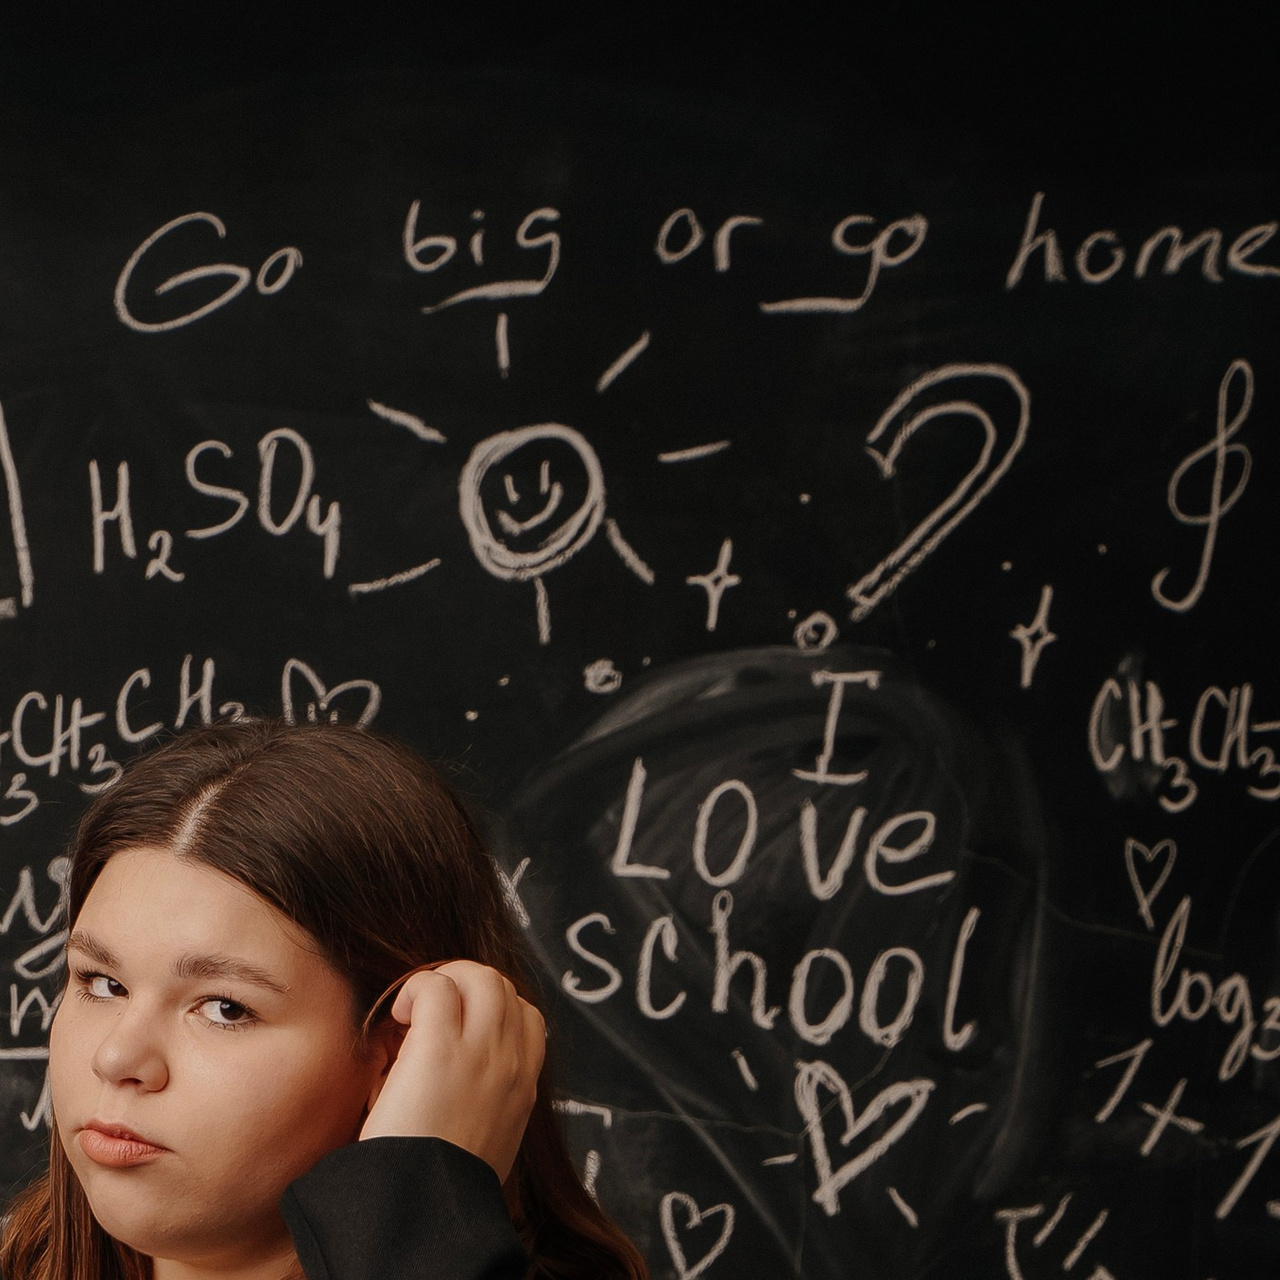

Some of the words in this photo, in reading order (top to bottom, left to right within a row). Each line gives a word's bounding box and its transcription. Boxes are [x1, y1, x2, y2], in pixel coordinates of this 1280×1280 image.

[114, 211, 304, 334] Go
[402, 199, 562, 314] big
[655, 206, 762, 273] or
[758, 212, 928, 315] go
[1006, 191, 1280, 289] home
[792, 670, 882, 785] I
